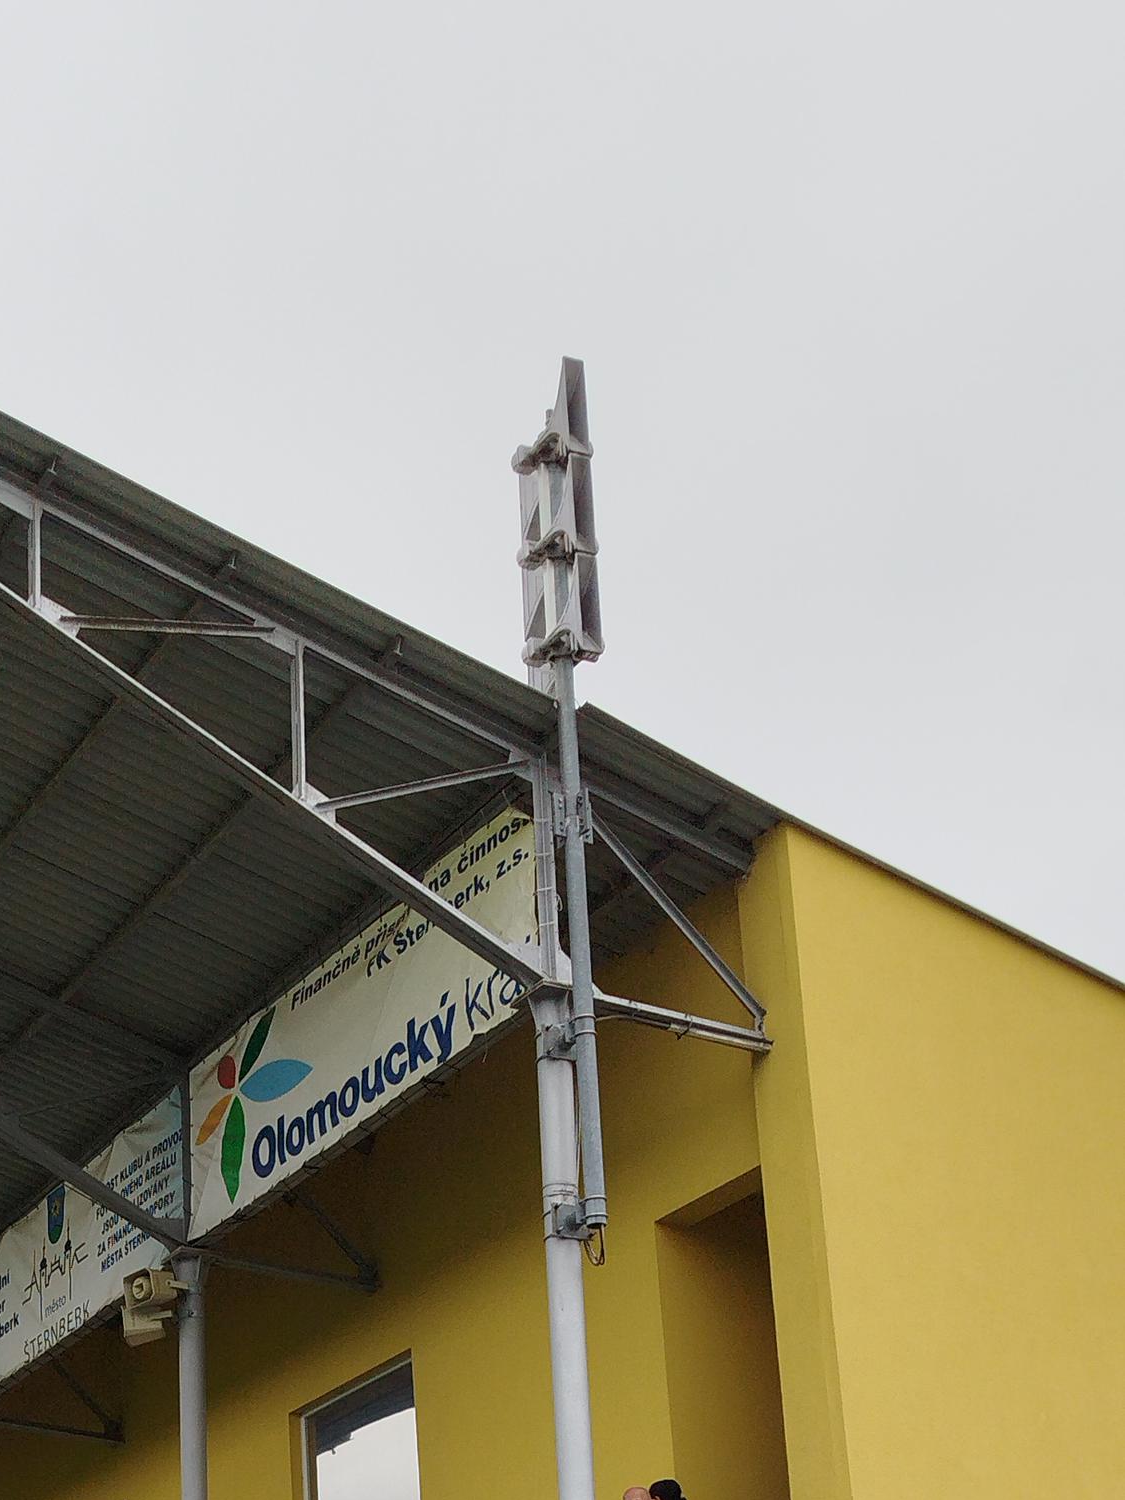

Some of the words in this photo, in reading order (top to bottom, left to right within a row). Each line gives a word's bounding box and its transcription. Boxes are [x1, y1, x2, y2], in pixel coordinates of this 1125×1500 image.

[291, 948, 361, 1011] Finančně
[252, 993, 456, 1178] Olomoucký
[465, 948, 528, 1031] kra
[119, 1154, 143, 1184] KLUBU
[23, 1299, 91, 1364] ŠTERNBERK
[44, 1295, 67, 1319] město
